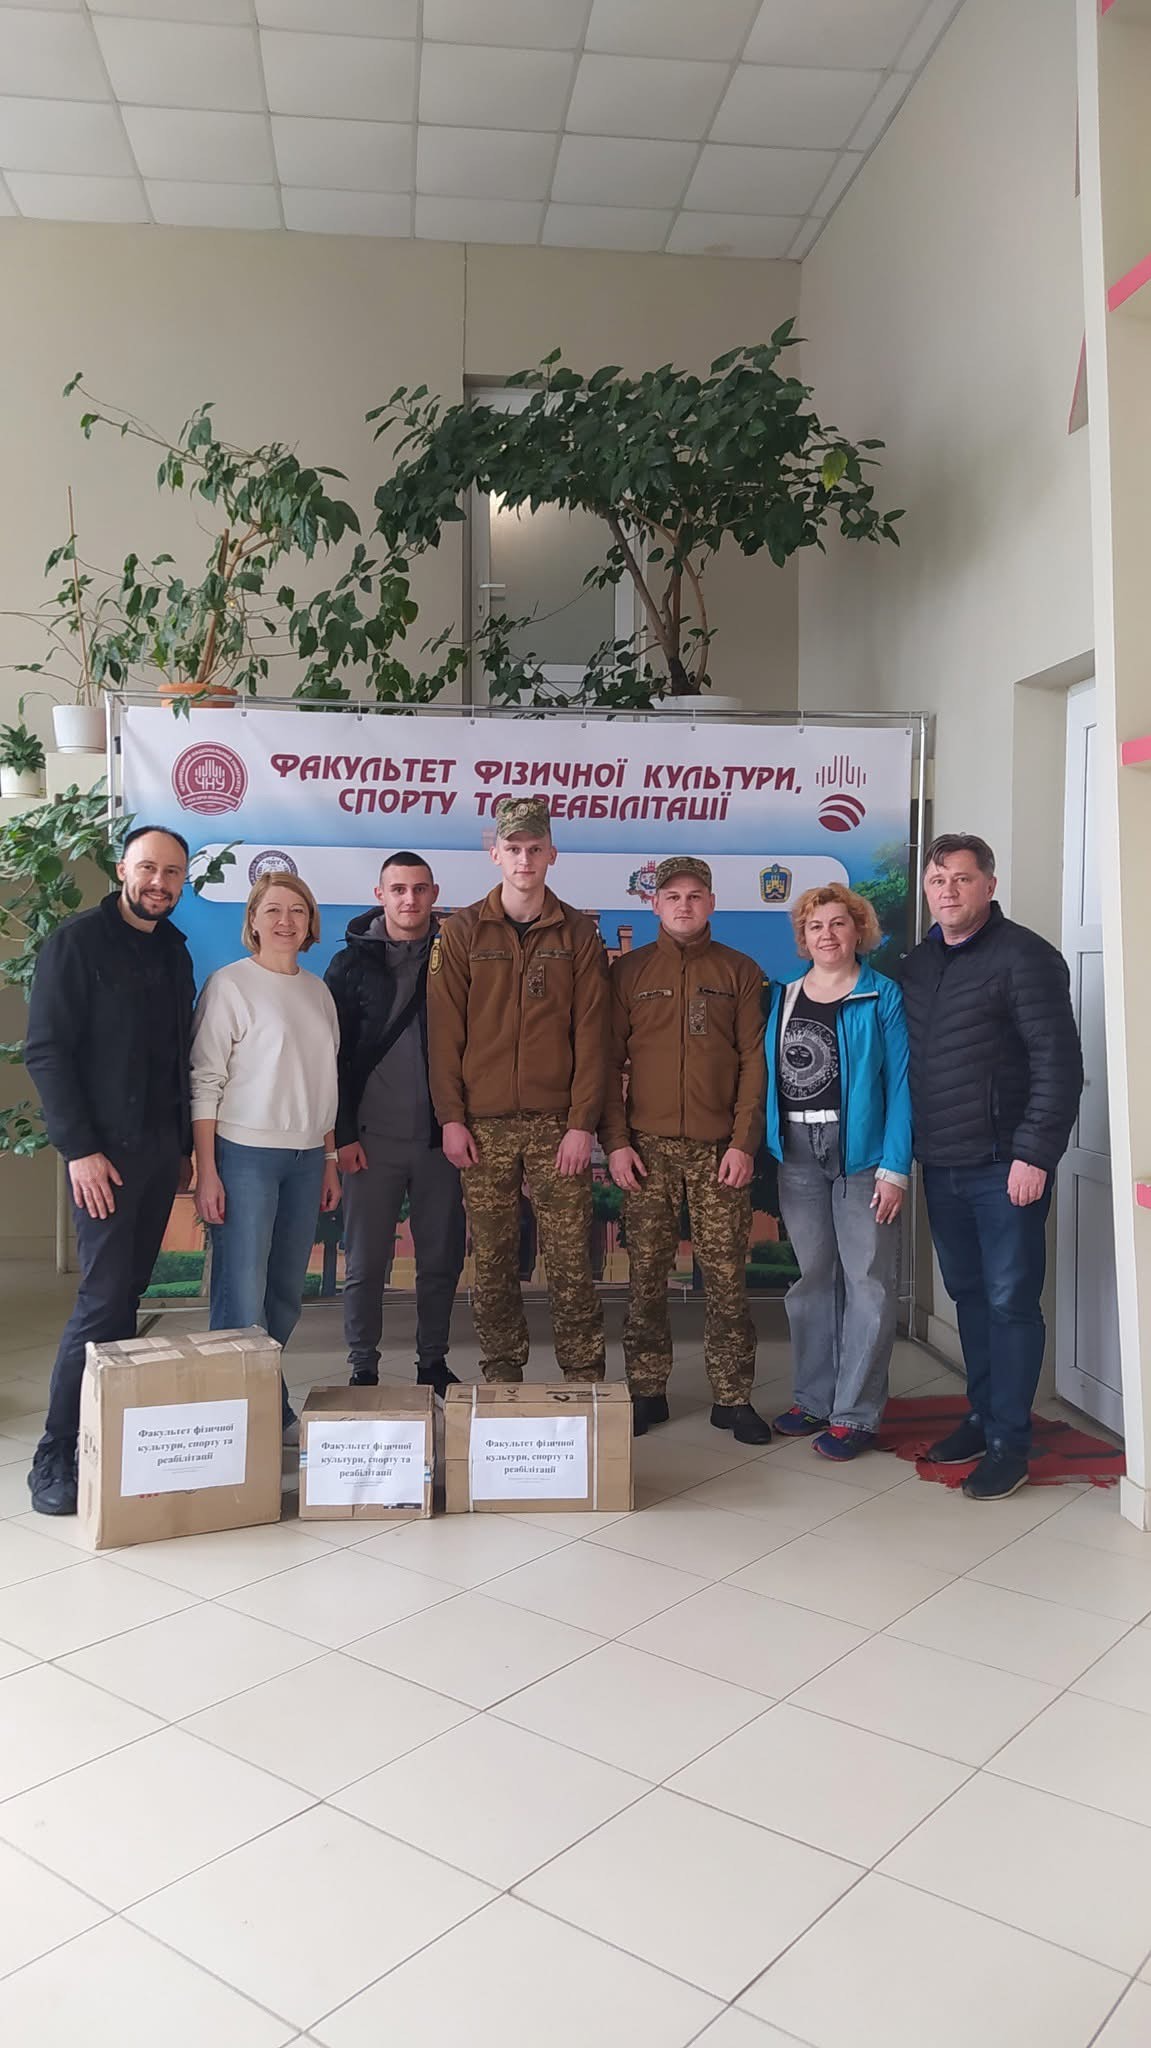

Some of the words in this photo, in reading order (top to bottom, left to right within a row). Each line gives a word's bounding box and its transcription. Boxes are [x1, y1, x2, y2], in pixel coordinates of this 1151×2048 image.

[270, 754, 457, 784] ФАКУЛЬТЕТ
[474, 758, 629, 790] ФІЗИЧНОЇ
[643, 765, 802, 794] КУЛЬТУРИ,
[194, 777, 226, 791] ЧНУ
[338, 788, 458, 816] СПОРТУ
[138, 1428, 190, 1439] Факультет
[193, 1423, 234, 1436] фізичної
[137, 1443, 186, 1454] культури,
[188, 1439, 220, 1449] спорту
[321, 1442, 370, 1451] Факультет
[373, 1442, 412, 1452] фізичної
[485, 1440, 533, 1449] Факультет
[536, 1439, 574, 1449] фізичної
[157, 1452, 213, 1466] реабілітації
[321, 1456, 366, 1465] культури,
[368, 1456, 399, 1465] спорту
[531, 1454, 561, 1462] спорту
[339, 1468, 392, 1479] реабілітації
[504, 1465, 556, 1475] реабілітації
